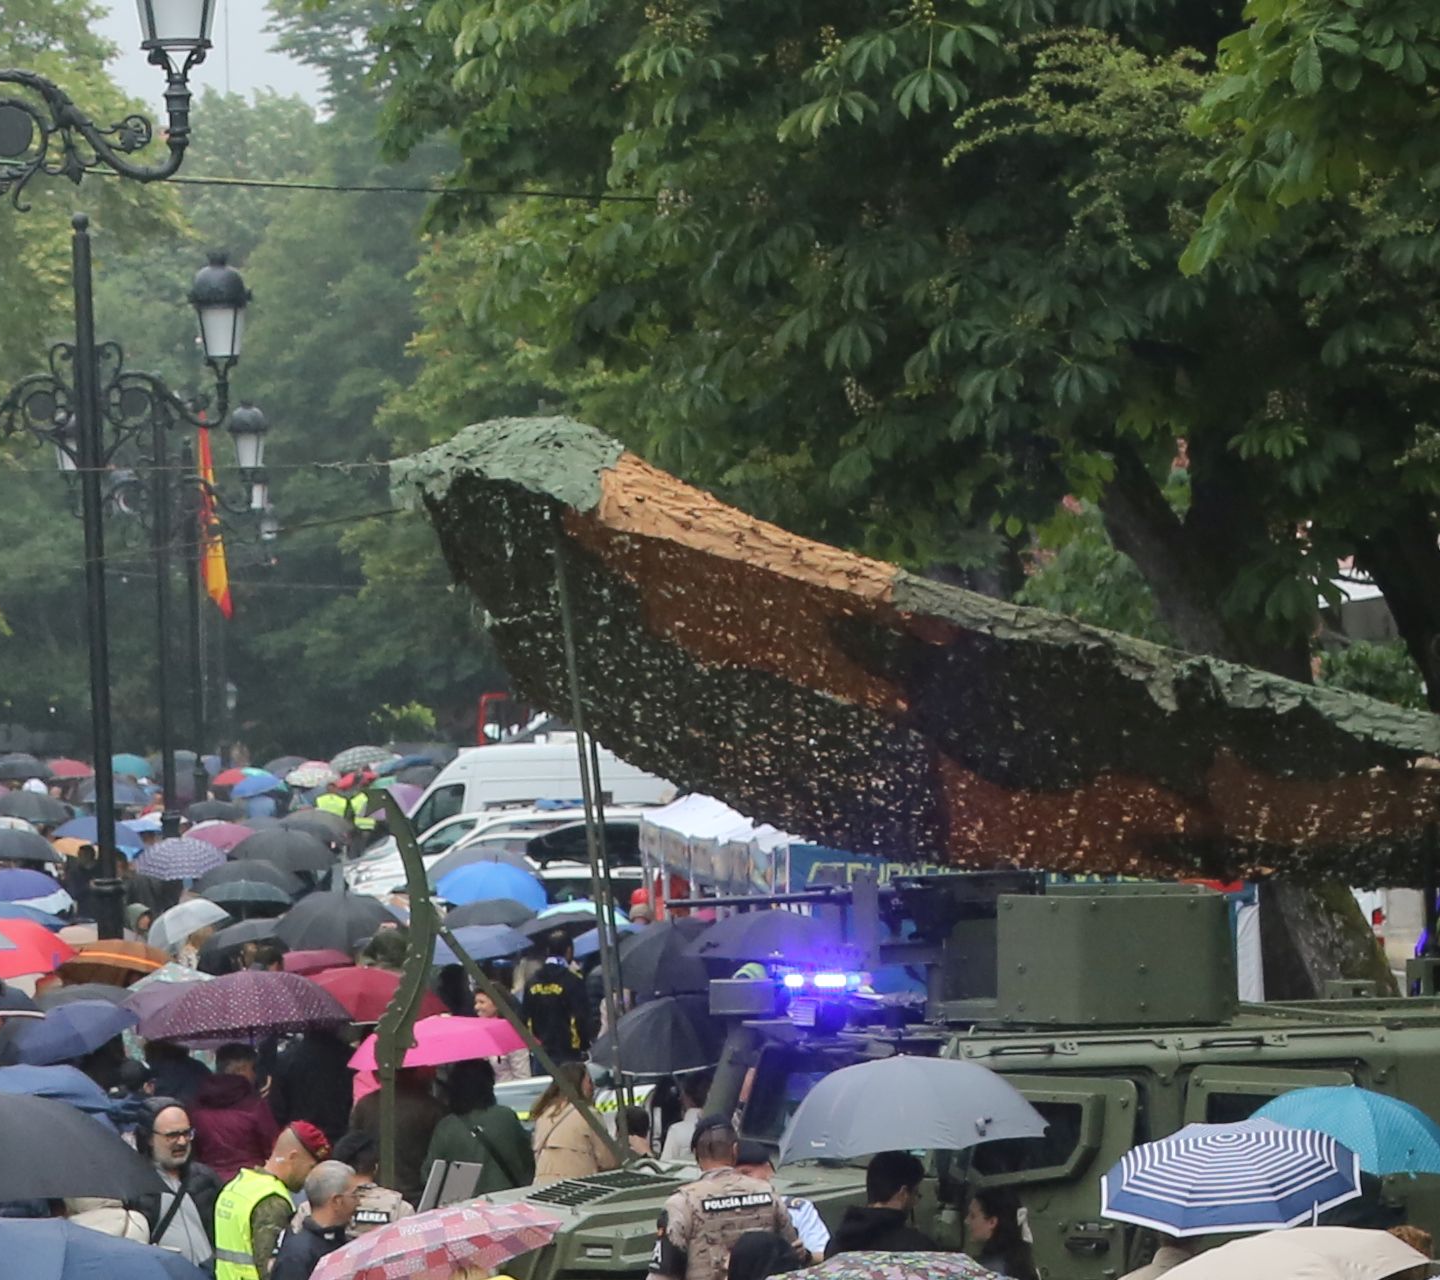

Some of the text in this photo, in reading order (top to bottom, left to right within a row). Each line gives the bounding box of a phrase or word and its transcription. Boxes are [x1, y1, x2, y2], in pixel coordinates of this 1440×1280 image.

[704, 1194, 772, 1210] POLICÍA AÉREA
[356, 1209, 388, 1223] AÉREA
